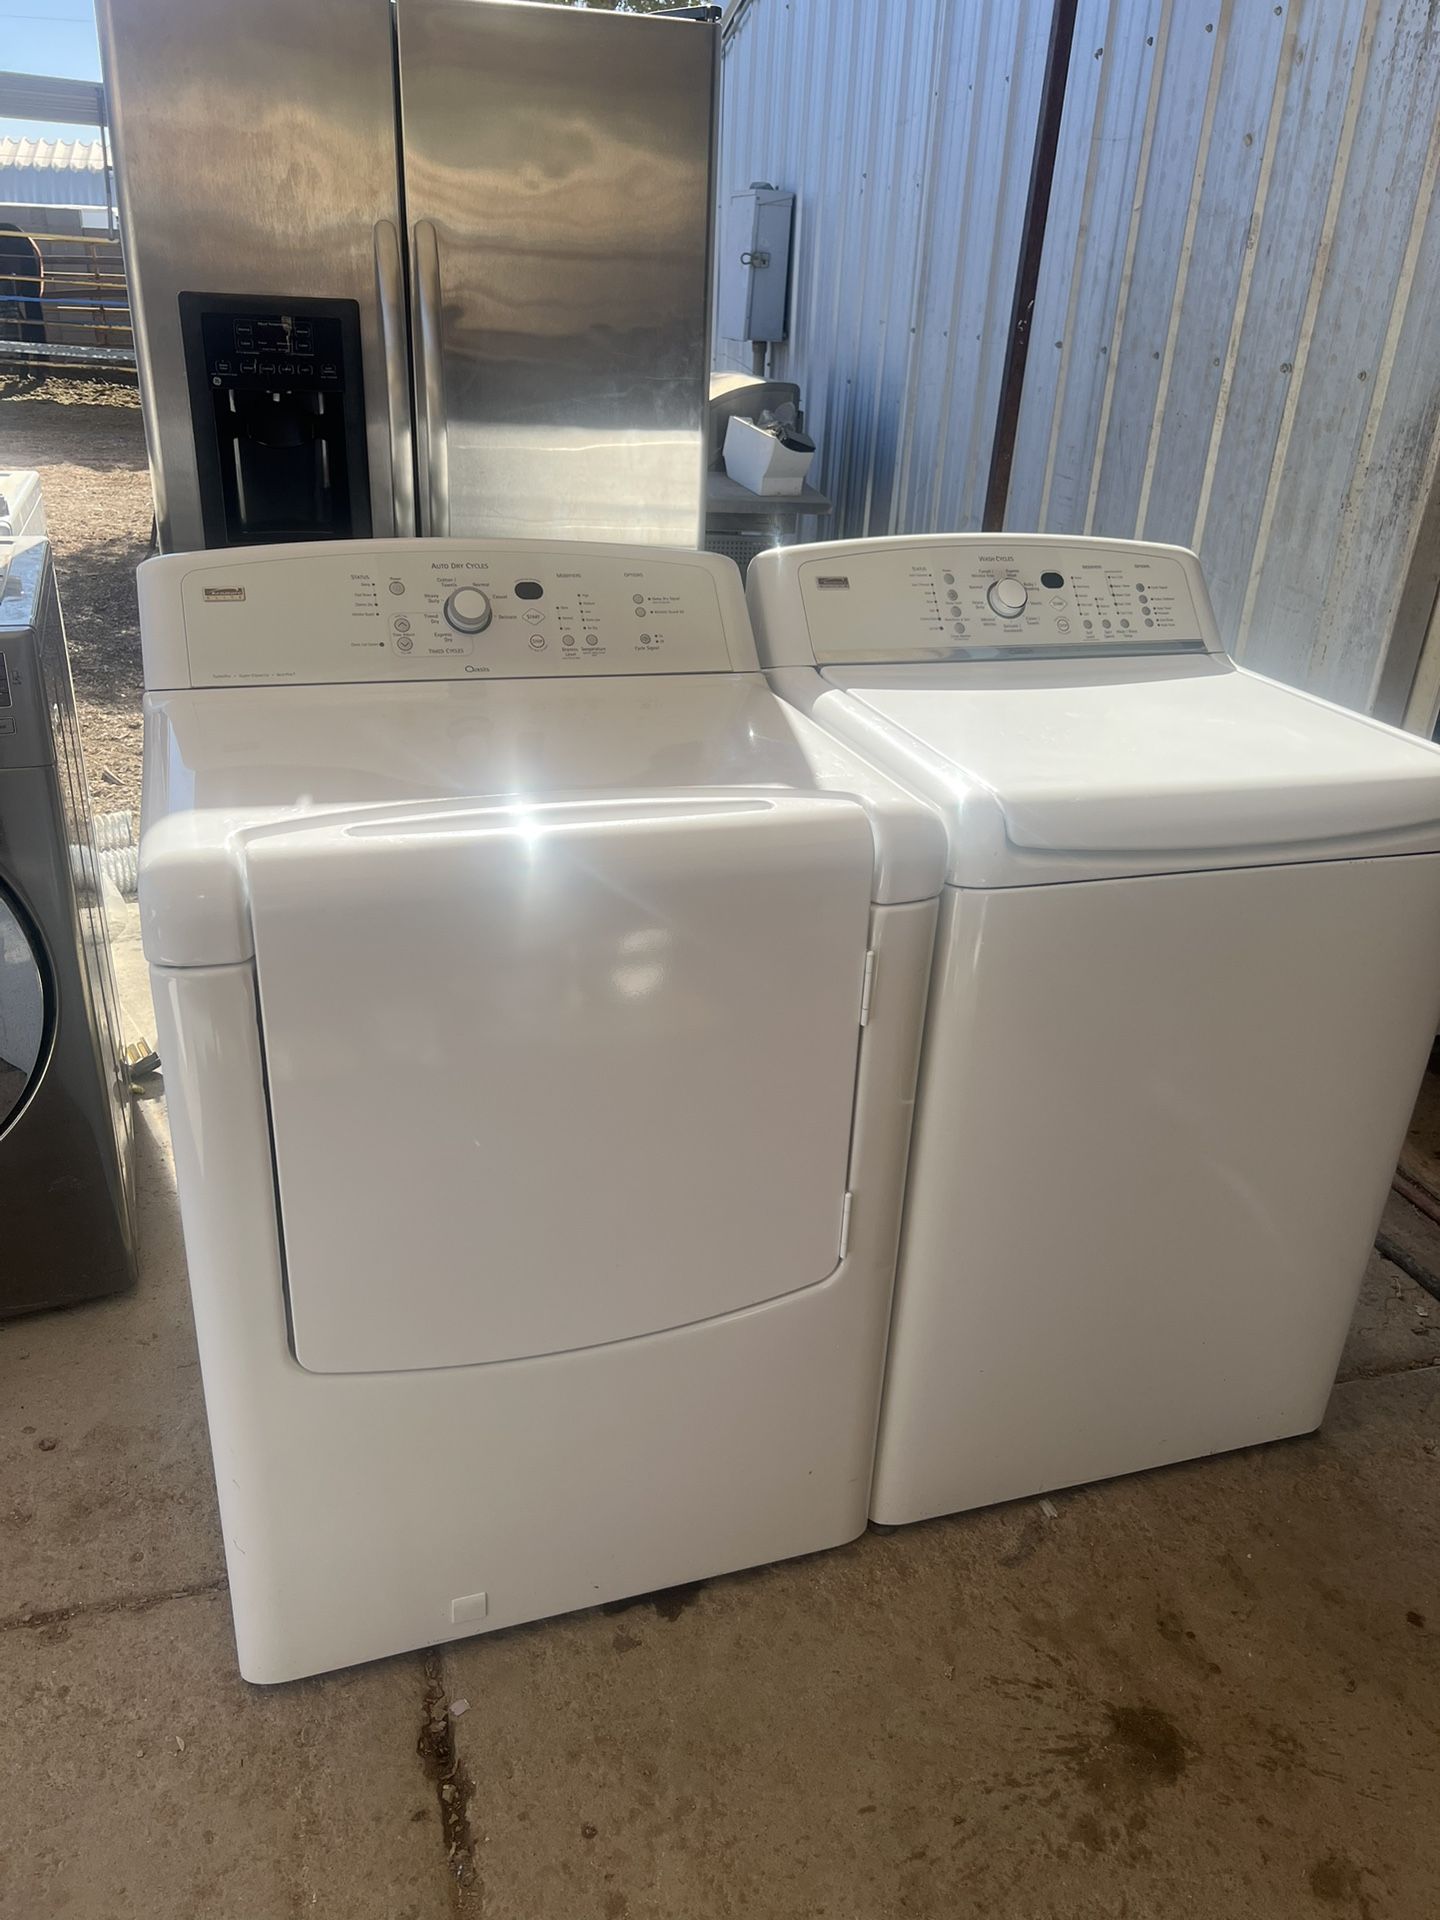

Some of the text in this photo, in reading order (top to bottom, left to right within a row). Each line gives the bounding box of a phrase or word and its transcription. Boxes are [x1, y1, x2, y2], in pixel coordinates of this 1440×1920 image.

[431, 562, 489, 570] AUTO DRY CYCLES
